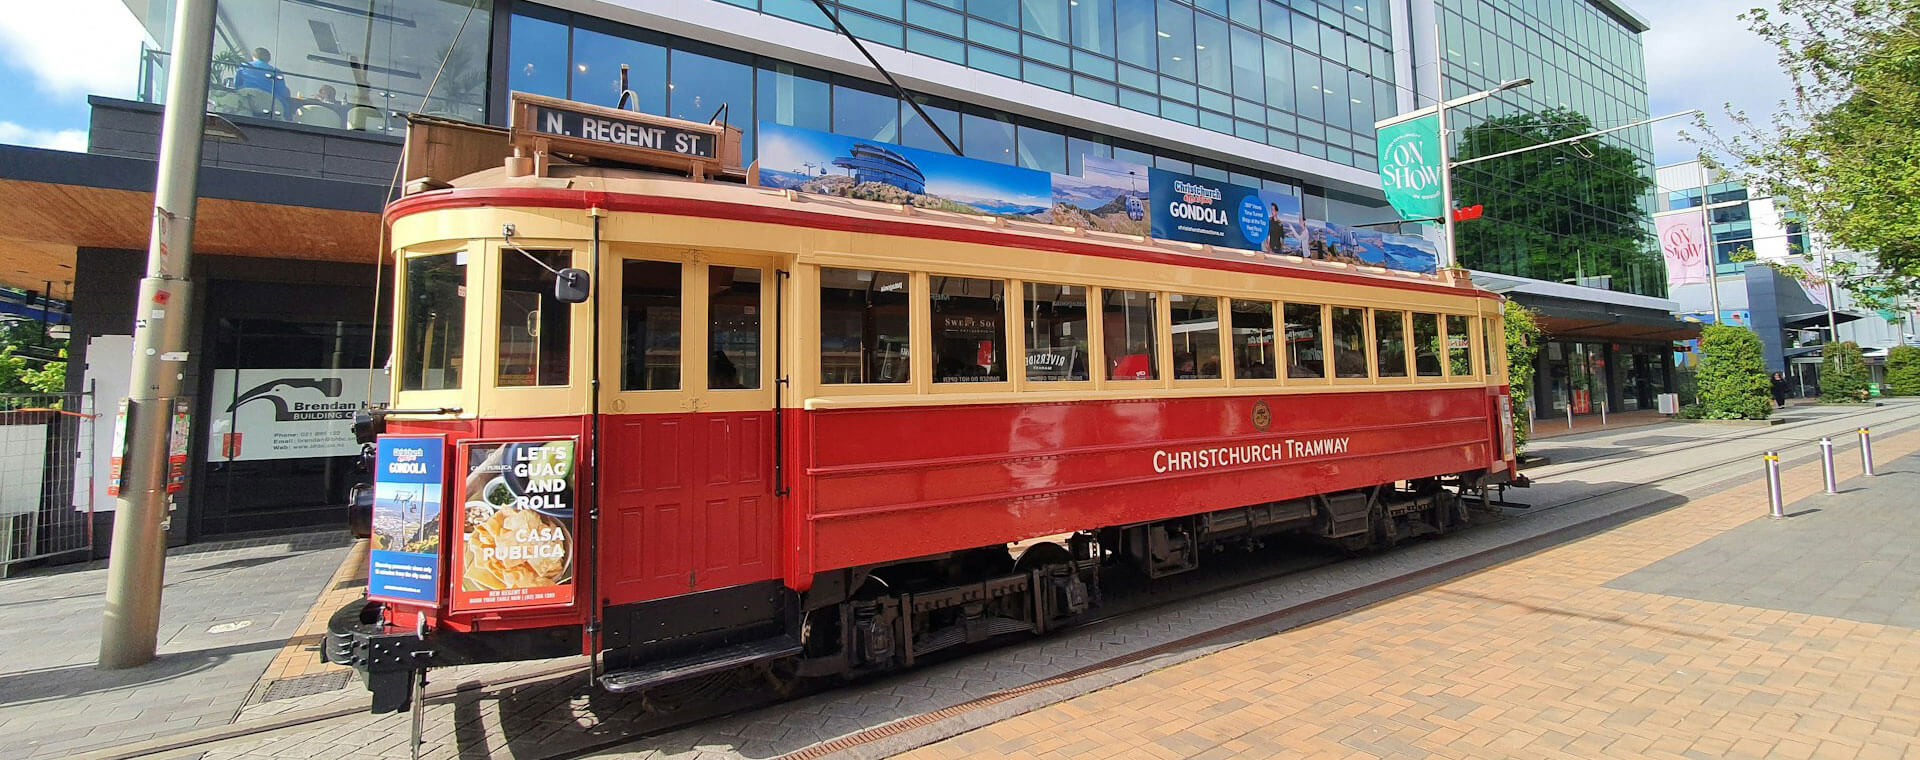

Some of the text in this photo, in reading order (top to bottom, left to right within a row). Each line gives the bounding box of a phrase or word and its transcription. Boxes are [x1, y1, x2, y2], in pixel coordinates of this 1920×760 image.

[546, 111, 705, 156] N. REGENT ST.
[1393, 140, 1425, 167] ON
[1382, 163, 1441, 191] SHOW
[1174, 180, 1222, 200] Christchurch
[1169, 201, 1229, 226] GONDOLA
[294, 400, 356, 411] Brendan
[293, 411, 343, 421] BUILDING
[516, 446, 567, 461] LET'S
[1152, 437, 1350, 473] CHRISTCHURCH TRAMWAY
[388, 462, 427, 474] GONDOLA
[514, 462, 566, 477] GUAC
[525, 478, 566, 493] AND
[516, 494, 566, 510] ROLL
[515, 526, 565, 542] CASA
[482, 543, 566, 561] PUBLICA
